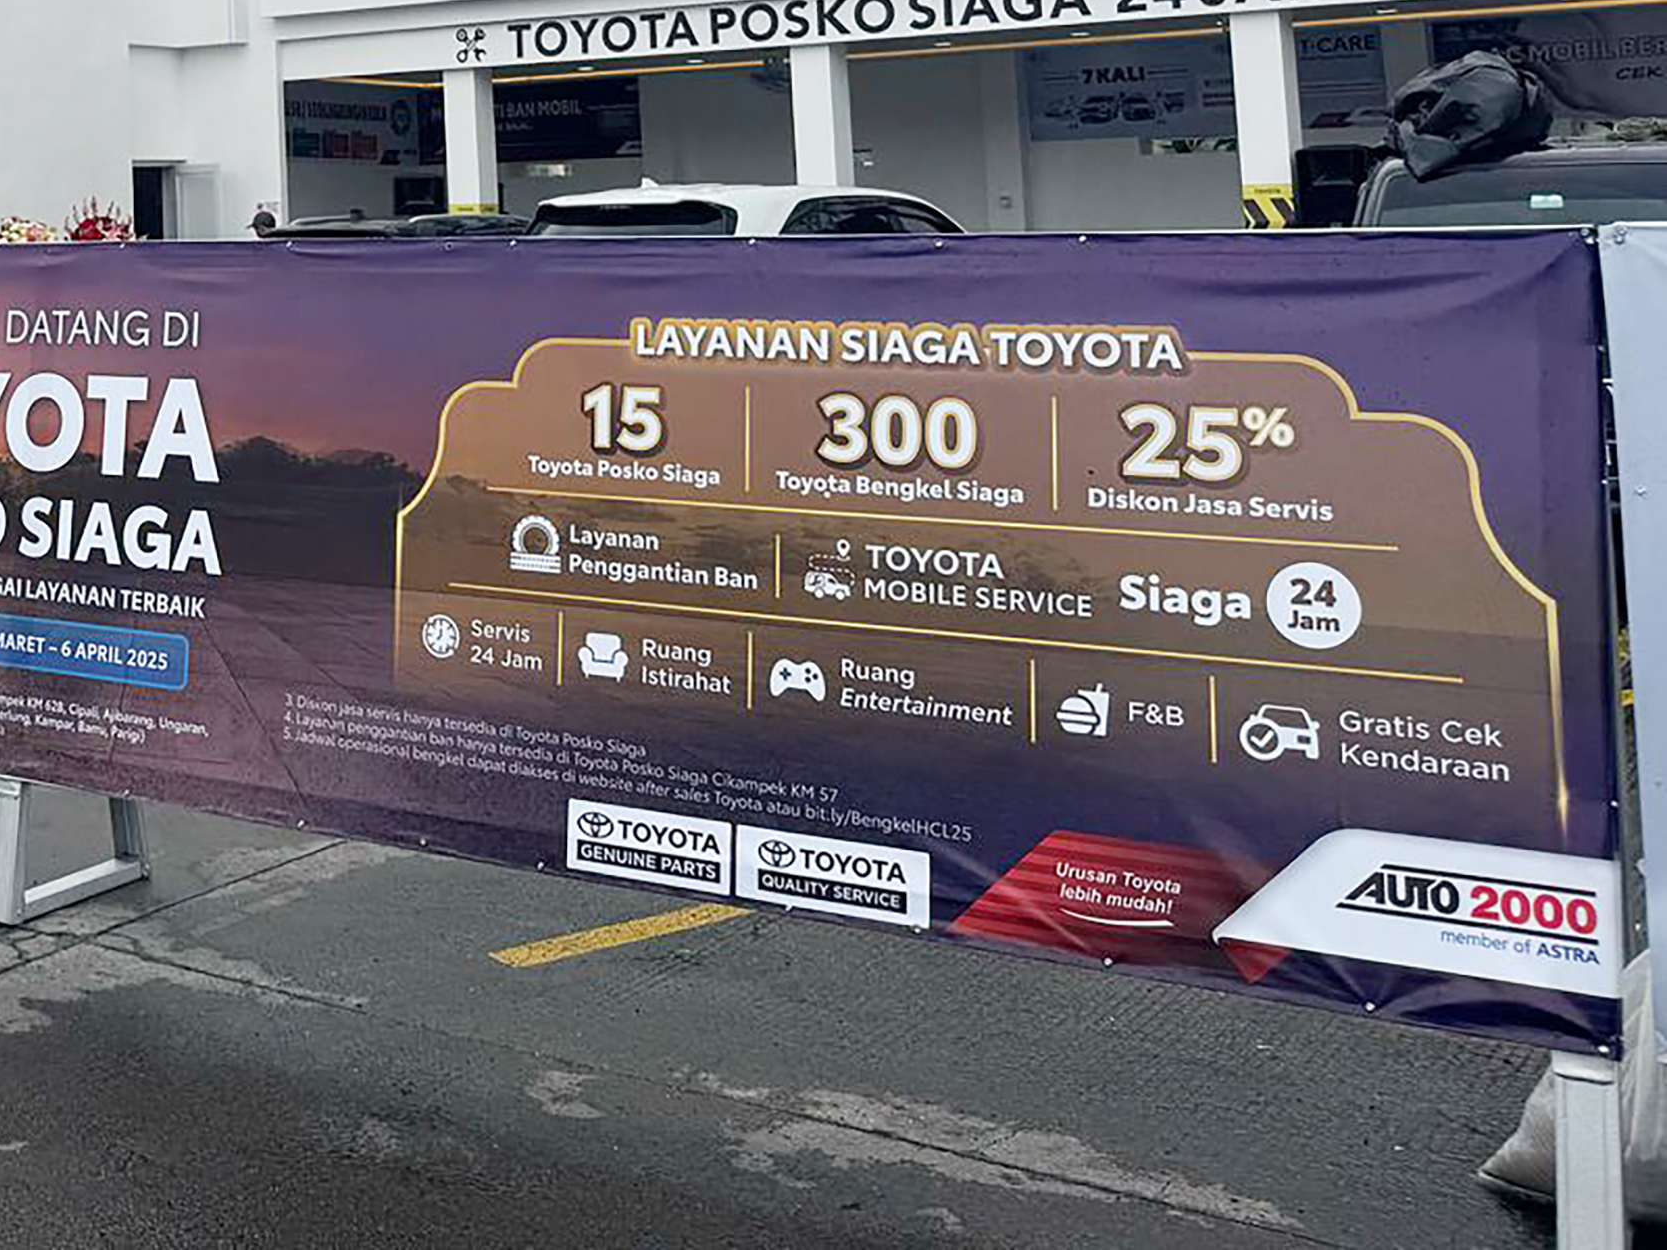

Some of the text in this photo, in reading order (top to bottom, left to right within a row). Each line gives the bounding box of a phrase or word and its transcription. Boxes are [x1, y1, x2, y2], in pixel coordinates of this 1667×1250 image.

[507, 11, 699, 58] TOYOTA
[6, 310, 149, 347] DATANG
[163, 312, 199, 348] DI
[635, 325, 1183, 370] LAYANAN SIAGA TOYOTA
[583, 383, 664, 451] 15
[817, 392, 978, 468] 300
[1121, 404, 1295, 482] 25%
[528, 455, 721, 487] Toyota Posko Siaga
[776, 471, 1025, 507] Toyota Bengkel Siaga
[1087, 487, 1334, 522] Diskon Jasa Servis
[18, 496, 221, 576] SIAGA
[569, 524, 660, 555] Layanan
[569, 556, 758, 589] Penggantian Ban
[865, 544, 1004, 579] TOYOTA
[26, 578, 116, 608] LAYANAN
[120, 589, 205, 618] TERBAIK
[864, 579, 1092, 617] MOBILE SERVICE
[1119, 574, 1252, 626] Siaga
[1289, 578, 1337, 608] 24
[471, 619, 531, 643] Servis
[1286, 610, 1341, 634] Jam
[61, 640, 72, 658] 6
[75, 642, 123, 666] APRIL
[126, 649, 168, 671] 2025
[469, 645, 543, 673] 24 Jam
[642, 639, 712, 667] Ruang
[641, 666, 731, 695] Istirahat
[840, 659, 915, 689] Ruang
[839, 689, 1013, 727] Entertainment
[1128, 701, 1185, 727] F&B
[297, 695, 336, 713] Diskon
[338, 702, 363, 717] jasa
[403, 709, 441, 730] hanya
[444, 717, 496, 736] tersedia
[516, 726, 559, 744] Toyota
[563, 732, 604, 751] Posko
[606, 738, 646, 759] Siaga
[1338, 710, 1503, 748] Gratis Cek
[296, 713, 345, 731] Layanan
[347, 722, 426, 742] penggantian
[429, 733, 453, 746] ban
[457, 735, 496, 755] hanya
[499, 743, 553, 762] tersedia
[556, 750, 570, 764] di
[573, 752, 618, 771] Toyota
[622, 759, 664, 778] Posko
[667, 766, 708, 787] Siaga
[712, 772, 786, 796] Cikampek
[791, 783, 814, 799] KM
[819, 787, 838, 802] 57
[1340, 741, 1511, 783] Kendaraan
[412, 747, 464, 767] bengkel
[467, 755, 506, 773] dapat
[508, 761, 559, 781] diakses
[562, 769, 576, 783] di
[578, 773, 633, 791] website
[636, 780, 669, 797] after
[673, 787, 710, 803] sales
[714, 790, 762, 811] Toyota
[766, 802, 800, 817] atau
[618, 820, 721, 855] TOYOTA
[581, 844, 716, 879] GENUINE PARTS
[799, 849, 906, 884] TOYOTA
[1055, 861, 1182, 897] Urusan Toyota
[761, 874, 900, 909] QUALITY SERVICE
[1059, 883, 1173, 915] lebih mudah!
[1342, 871, 1598, 936] AUTO 2000
[1440, 928, 1600, 966] member of ASTRA
